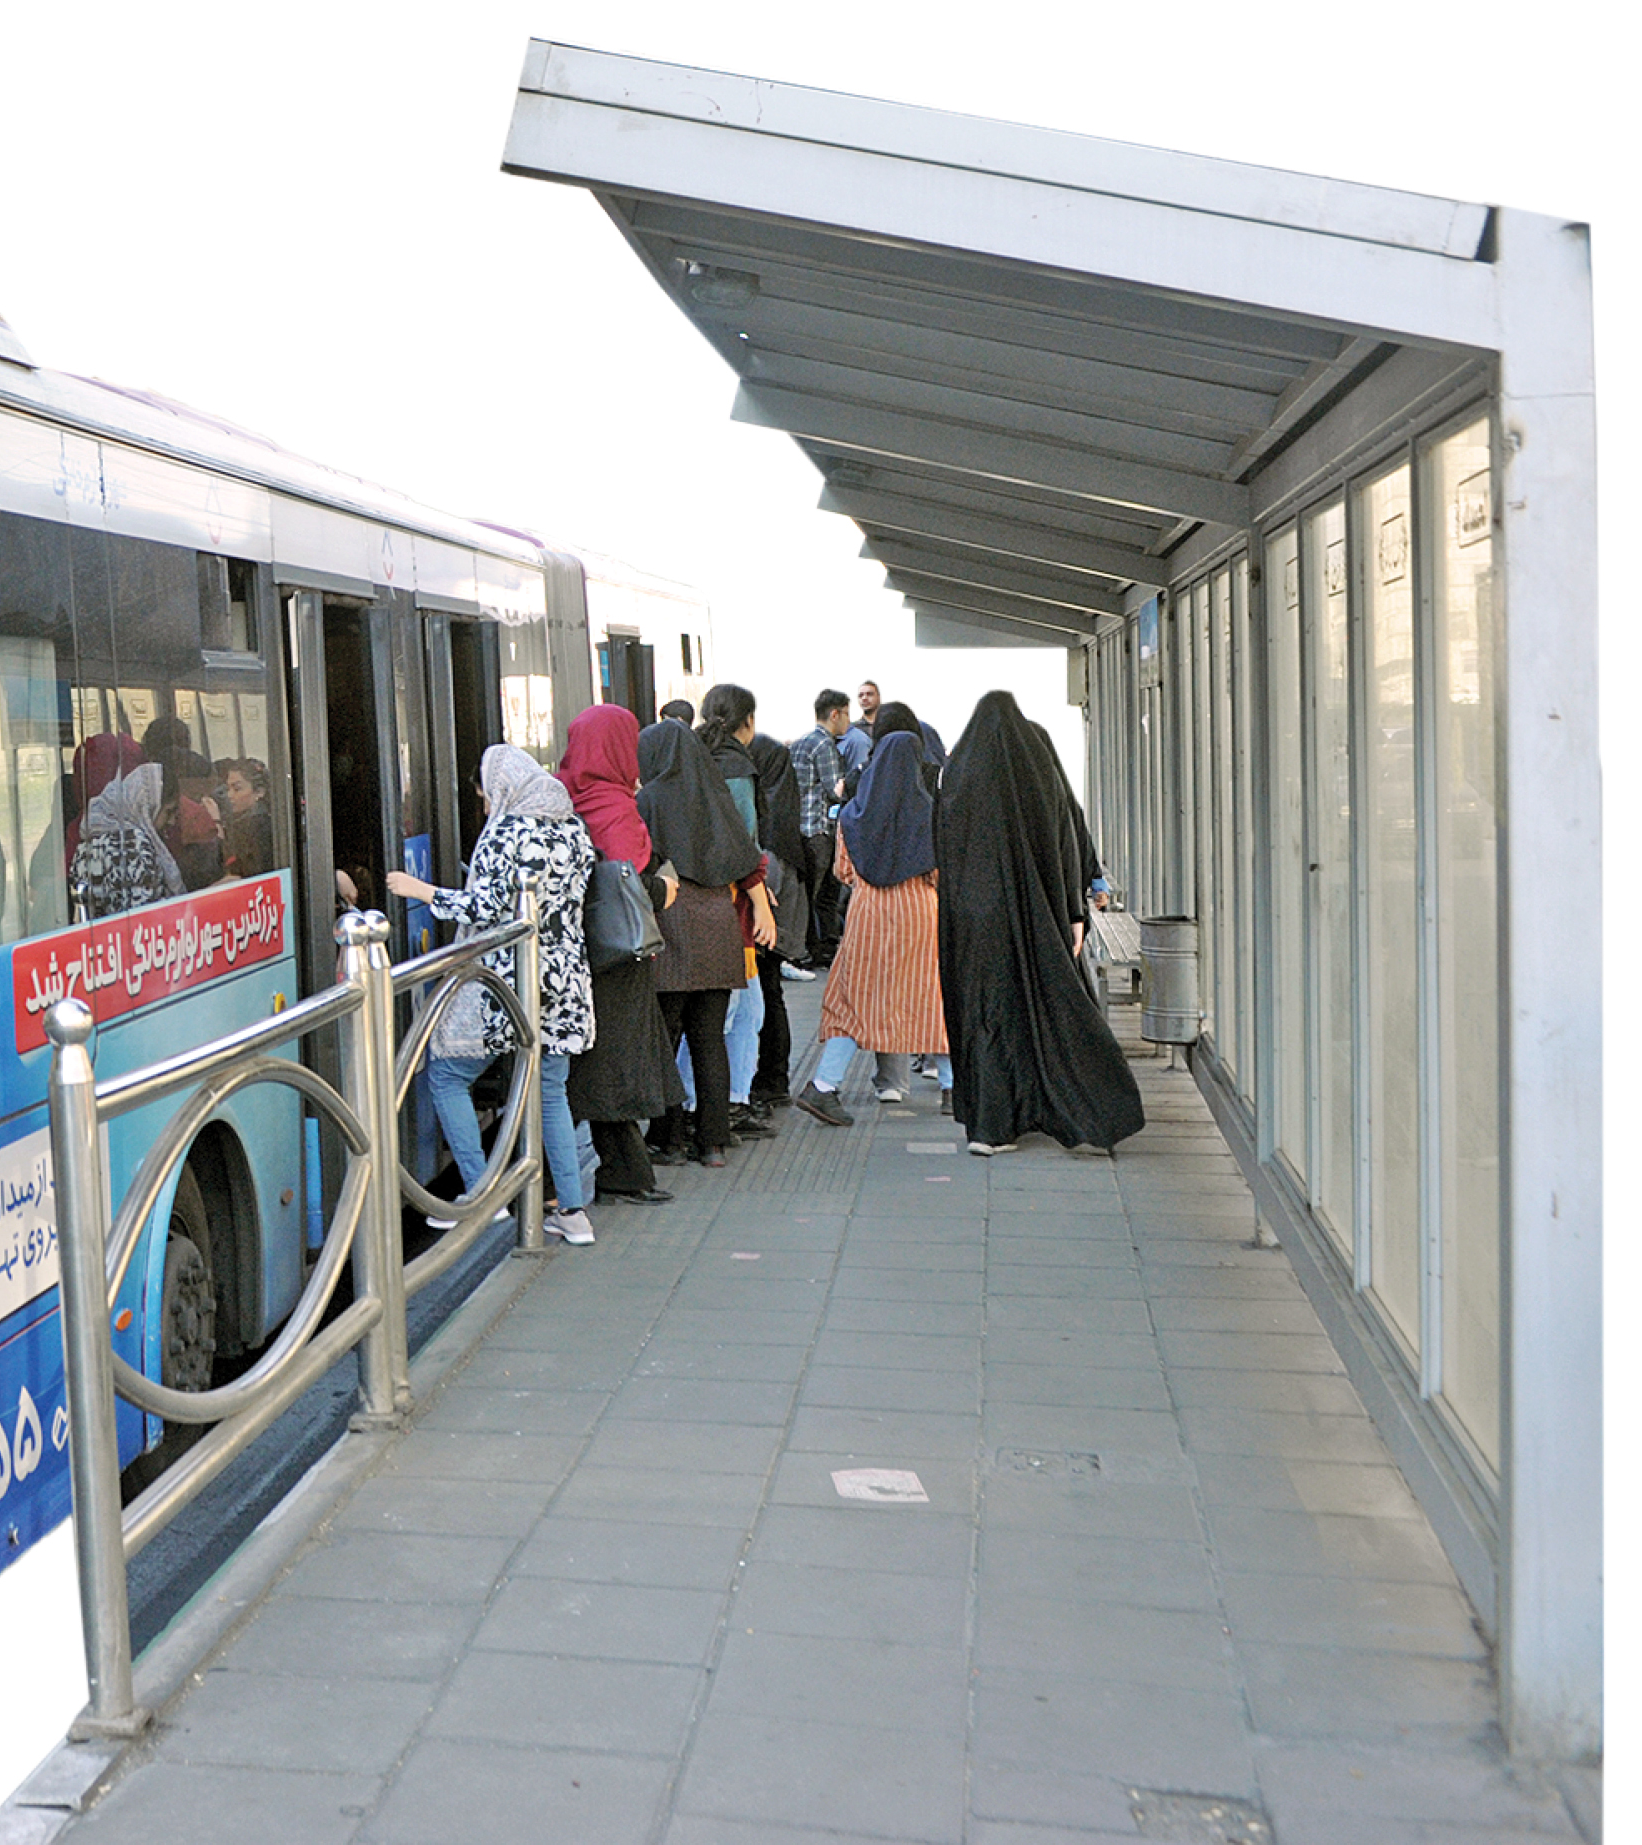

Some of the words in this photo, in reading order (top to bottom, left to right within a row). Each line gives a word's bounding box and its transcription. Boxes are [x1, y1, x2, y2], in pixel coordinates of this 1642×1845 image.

[224, 885, 279, 963] بزرگترین
[25, 950, 65, 1013] شد
[66, 932, 124, 999] افتتاح
[125, 922, 166, 997] خانگی
[35, 1158, 47, 1209] از
